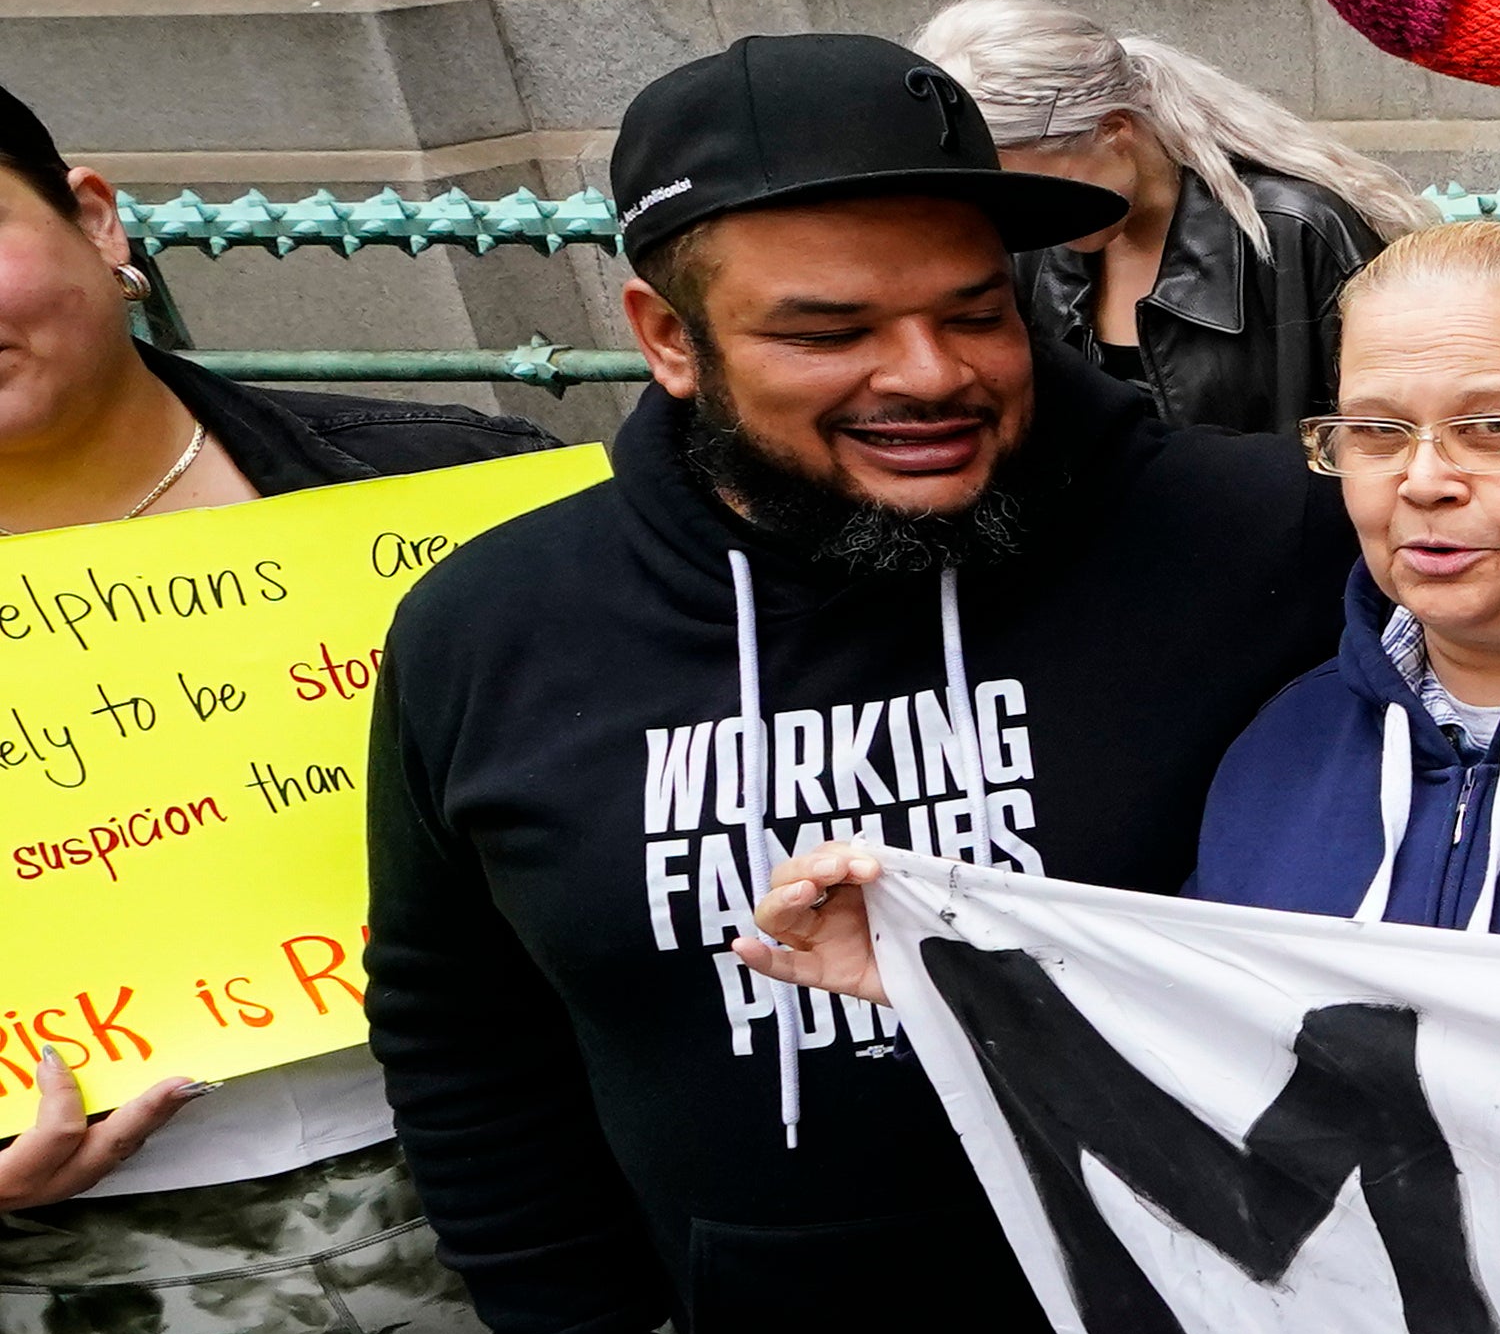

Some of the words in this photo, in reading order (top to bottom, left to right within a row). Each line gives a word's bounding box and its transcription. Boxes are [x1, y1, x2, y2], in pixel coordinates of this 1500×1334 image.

[0, 560, 288, 651] elphians
[371, 531, 459, 578] are
[0, 708, 87, 788] ely
[91, 685, 156, 738] to
[177, 673, 246, 722] be
[644, 679, 1034, 834] WORKING
[13, 796, 227, 882] suspicion
[245, 762, 356, 814] than
[646, 788, 1046, 951] FAIES
[195, 977, 274, 1028] is
